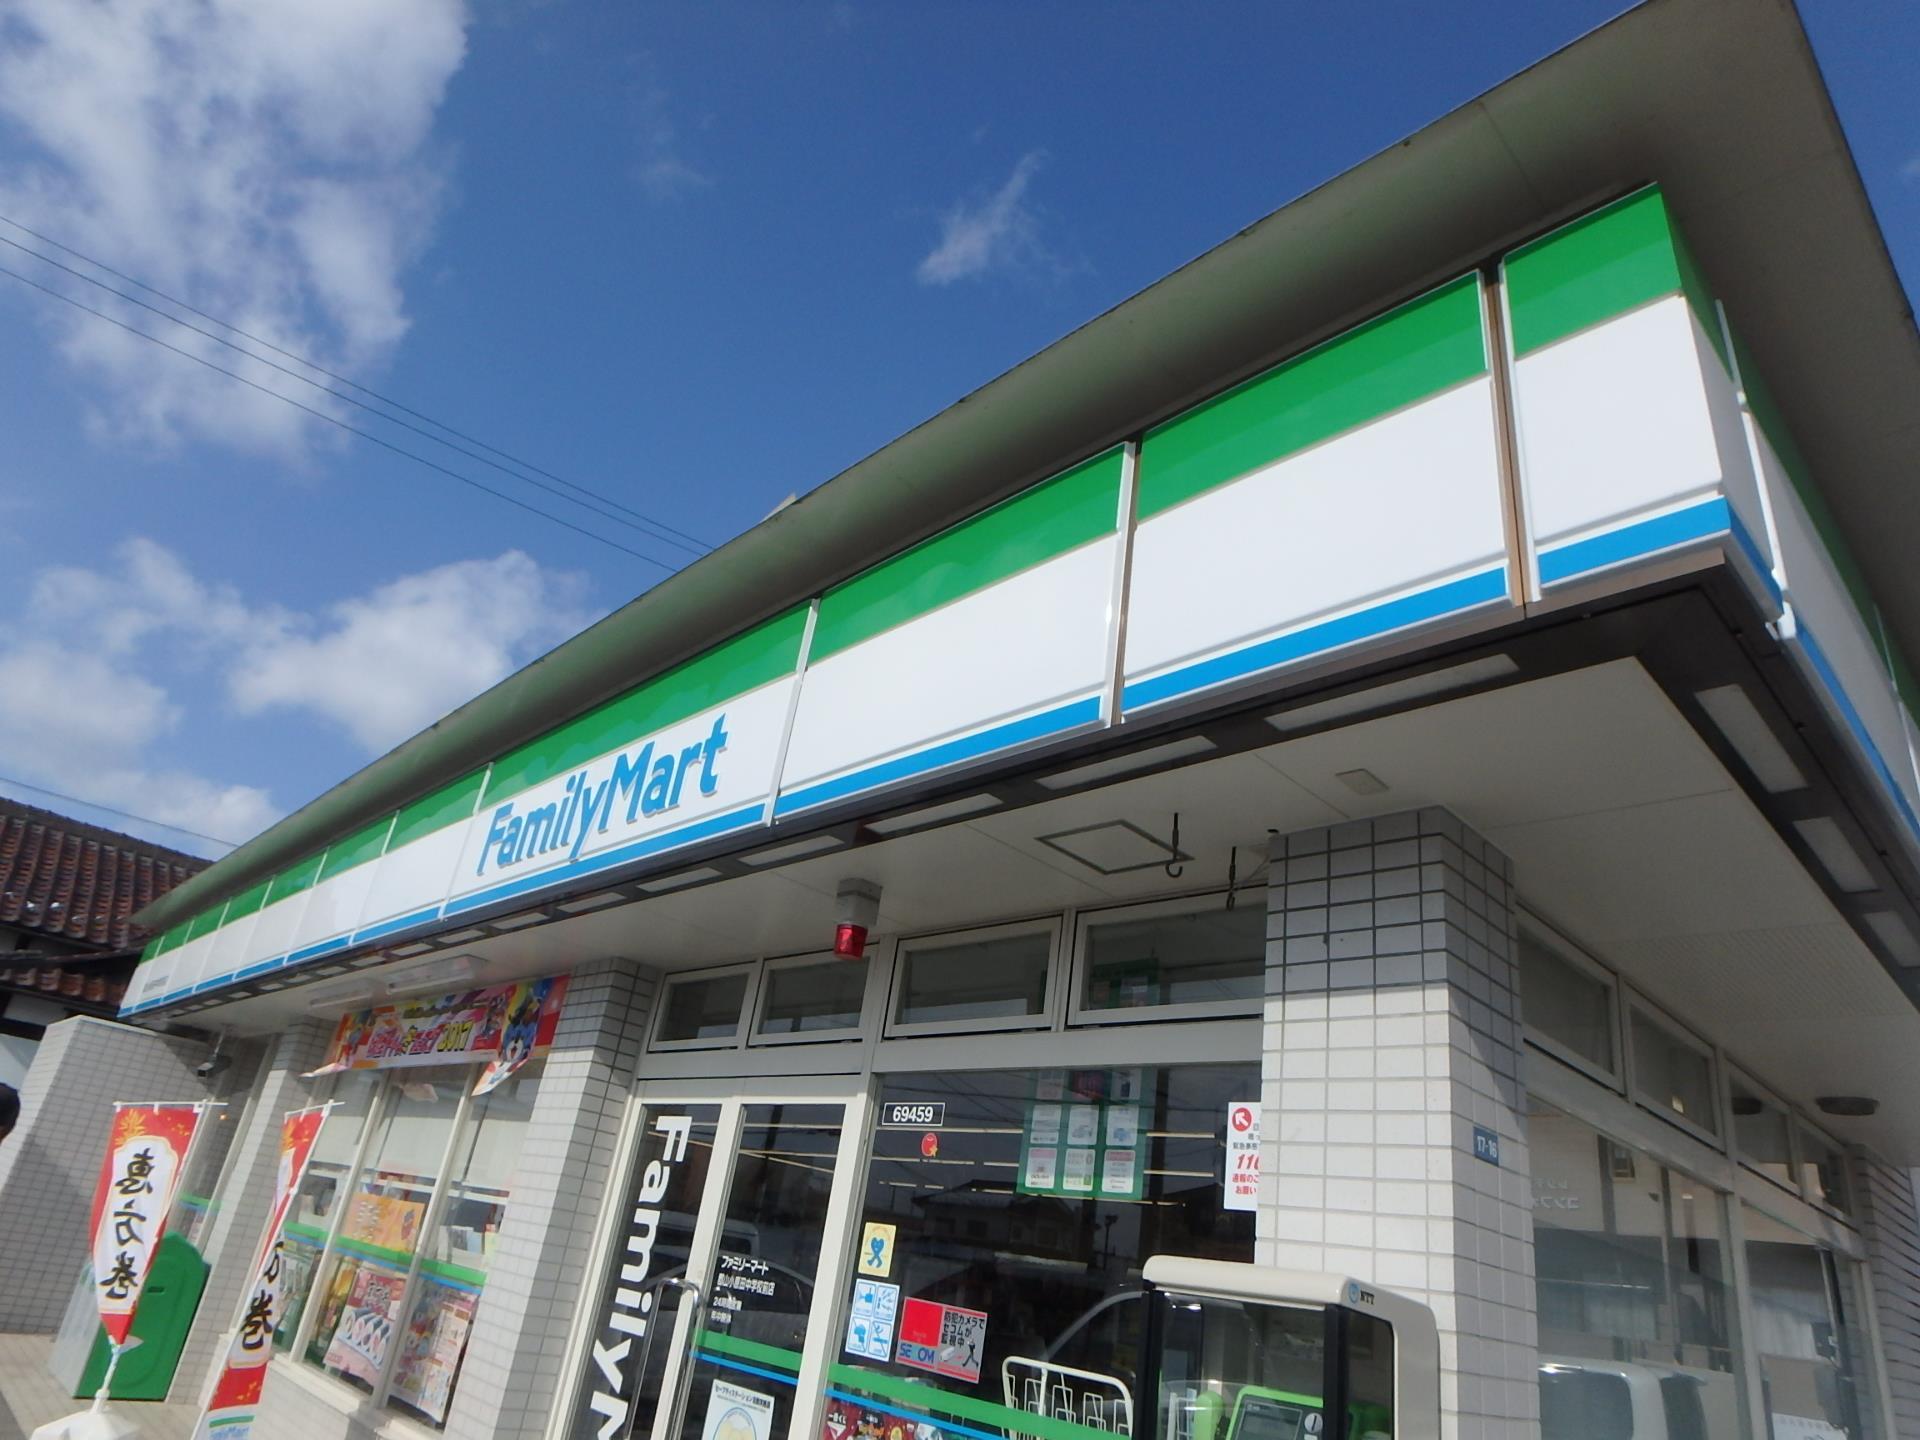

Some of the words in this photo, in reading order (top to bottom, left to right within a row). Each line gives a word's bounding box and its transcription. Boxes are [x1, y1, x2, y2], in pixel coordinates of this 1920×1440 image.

[476, 712, 729, 876] FamilyMart
[892, 1105, 934, 1122] 69459
[721, 1255, 769, 1276] ファミリーマート
[1360, 1290, 1375, 1305] NTT
[942, 1323, 973, 1338] セコムが
[900, 1343, 936, 1364] SEOM
